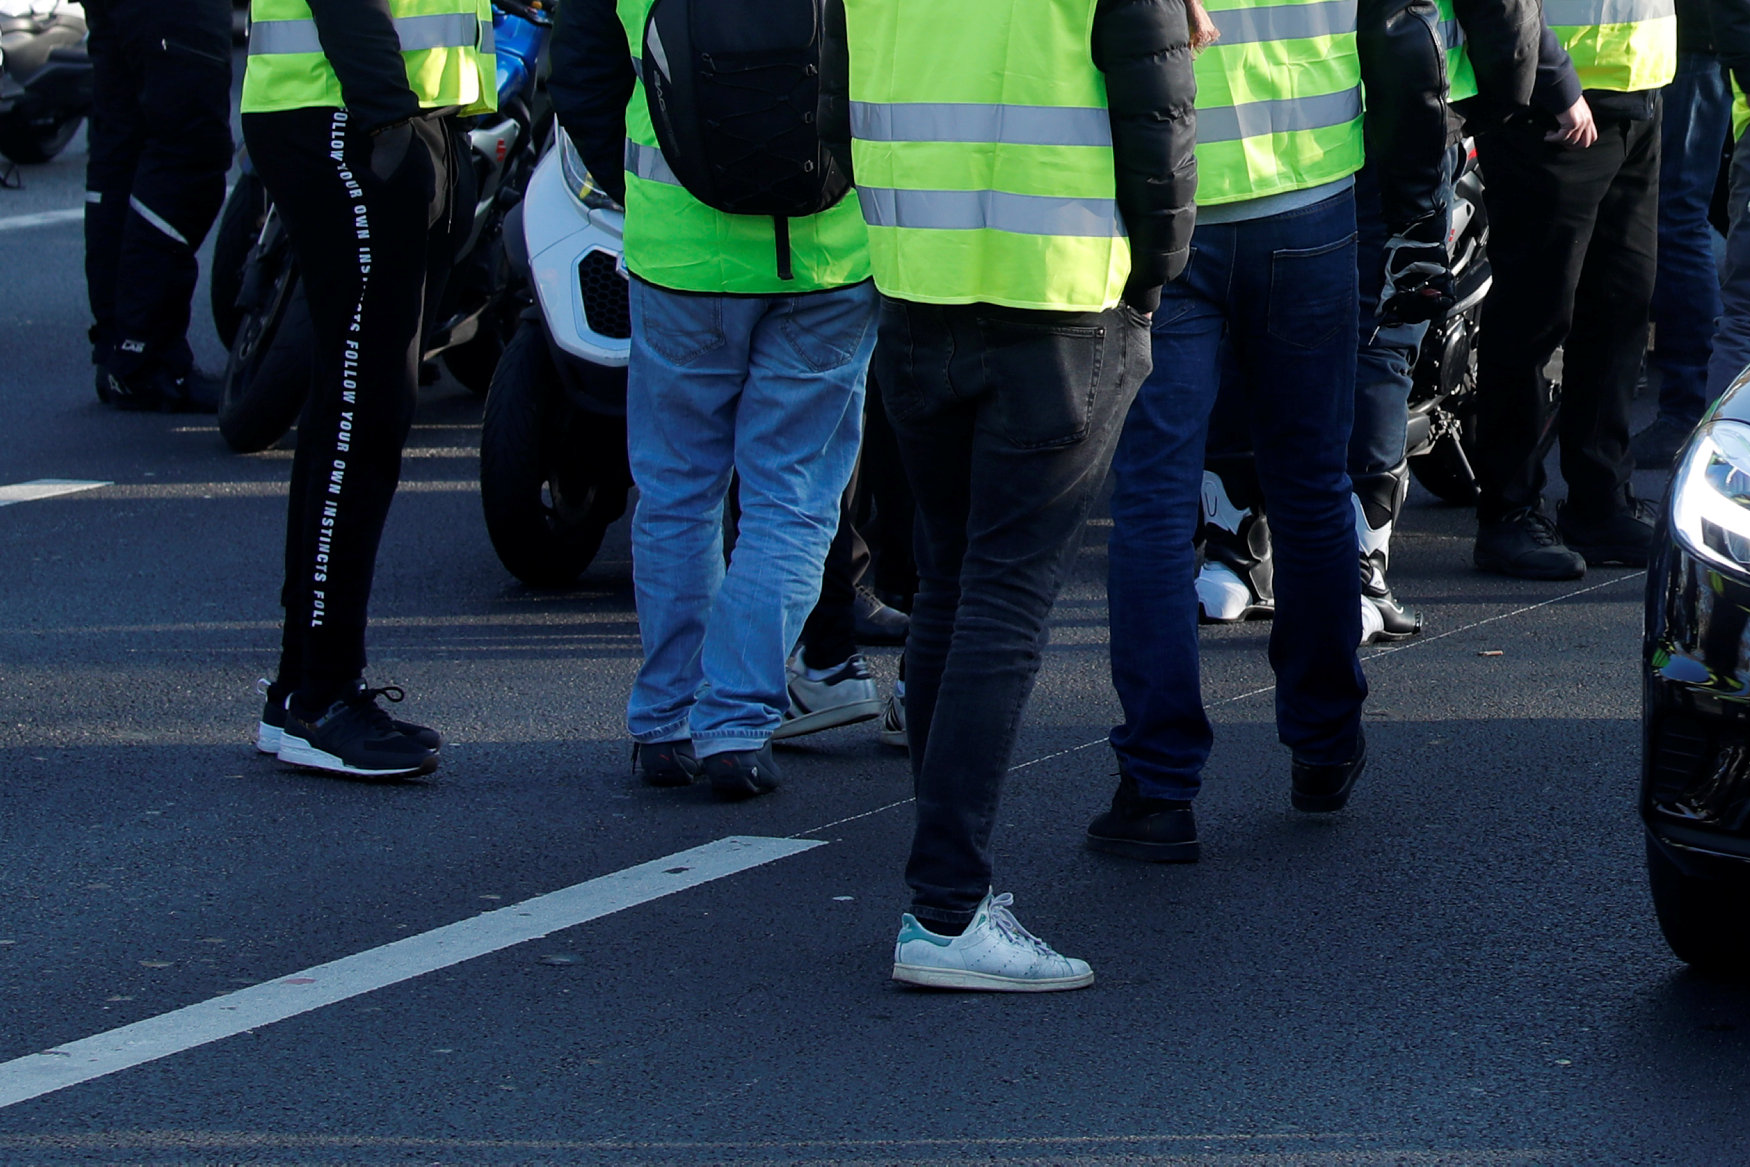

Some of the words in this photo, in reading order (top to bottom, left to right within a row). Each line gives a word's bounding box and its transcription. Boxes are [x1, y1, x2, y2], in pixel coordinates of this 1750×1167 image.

[338, 163, 362, 198] YOUR
[354, 206, 370, 239] OWN
[343, 341, 359, 404] FOLLOW
[337, 412, 353, 452] YOUR
[328, 460, 346, 494] OWN
[314, 500, 338, 582] INSTINCTS
